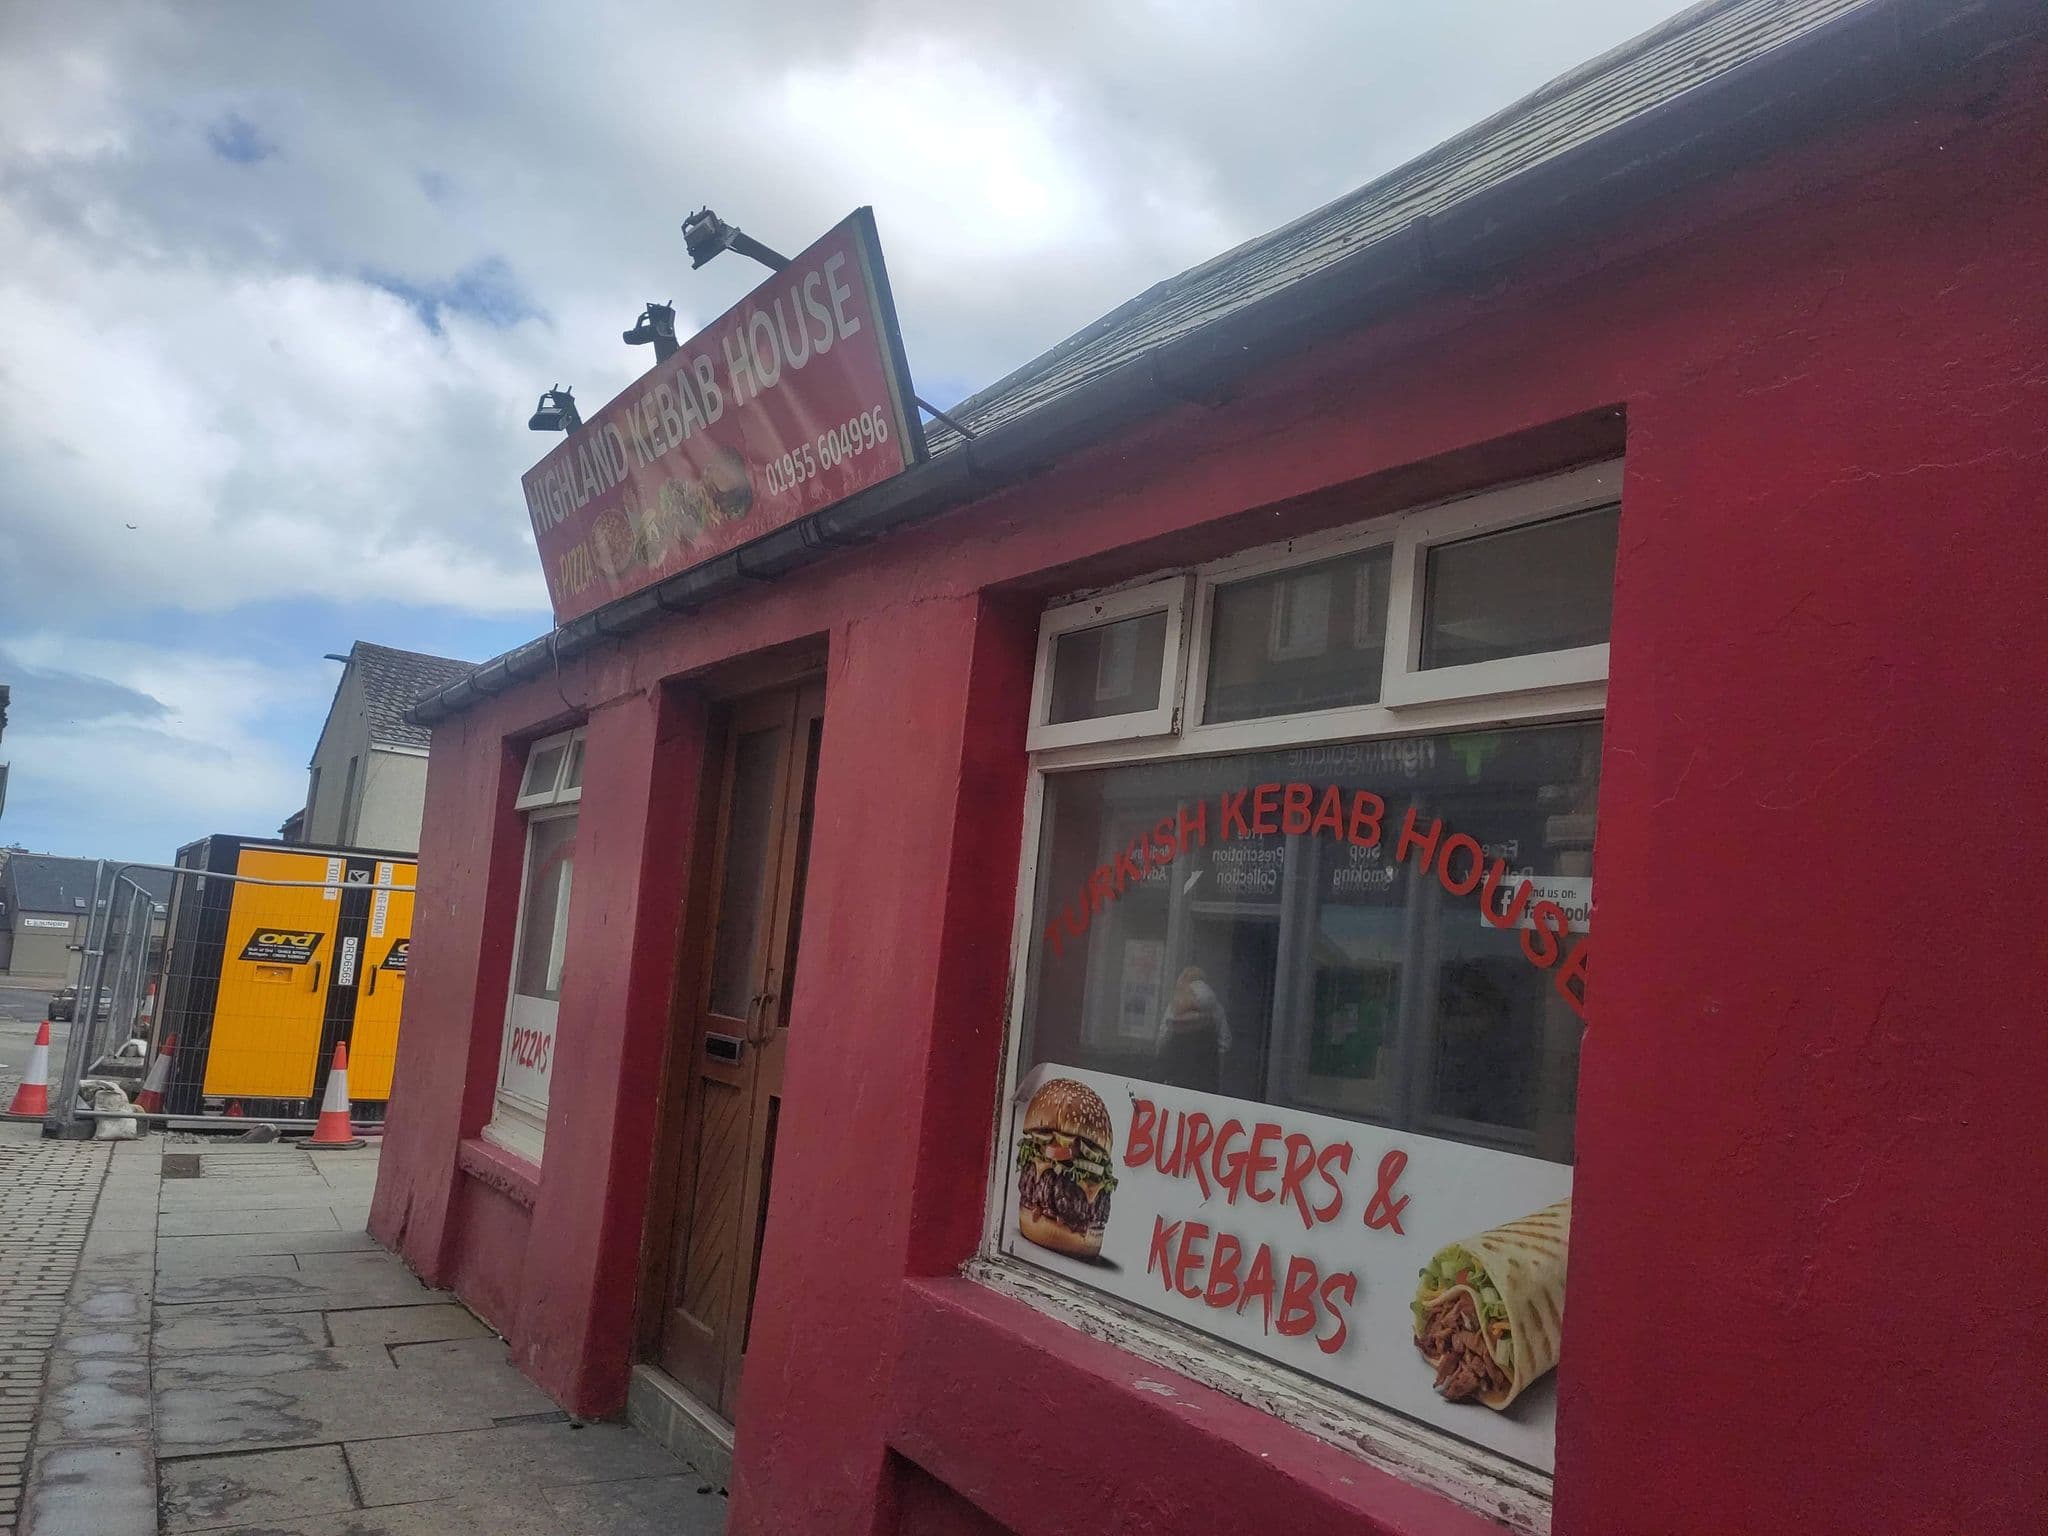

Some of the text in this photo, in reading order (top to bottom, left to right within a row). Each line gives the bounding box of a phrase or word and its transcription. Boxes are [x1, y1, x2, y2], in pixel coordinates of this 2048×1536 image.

[526, 251, 861, 537] HIGHLAND KEBAB HOUSE
[765, 404, 888, 496] 01955 604996
[325, 862, 340, 897] TOILT
[1042, 799, 1208, 960] TURKISH
[1220, 783, 1386, 849] KEBAB
[1547, 889, 1559, 899] us
[1561, 889, 1577, 899] on:
[511, 1026, 551, 1076] PIZZAS
[1123, 1098, 1412, 1236] BURGERS &
[1147, 1214, 1357, 1354] KEBABS
